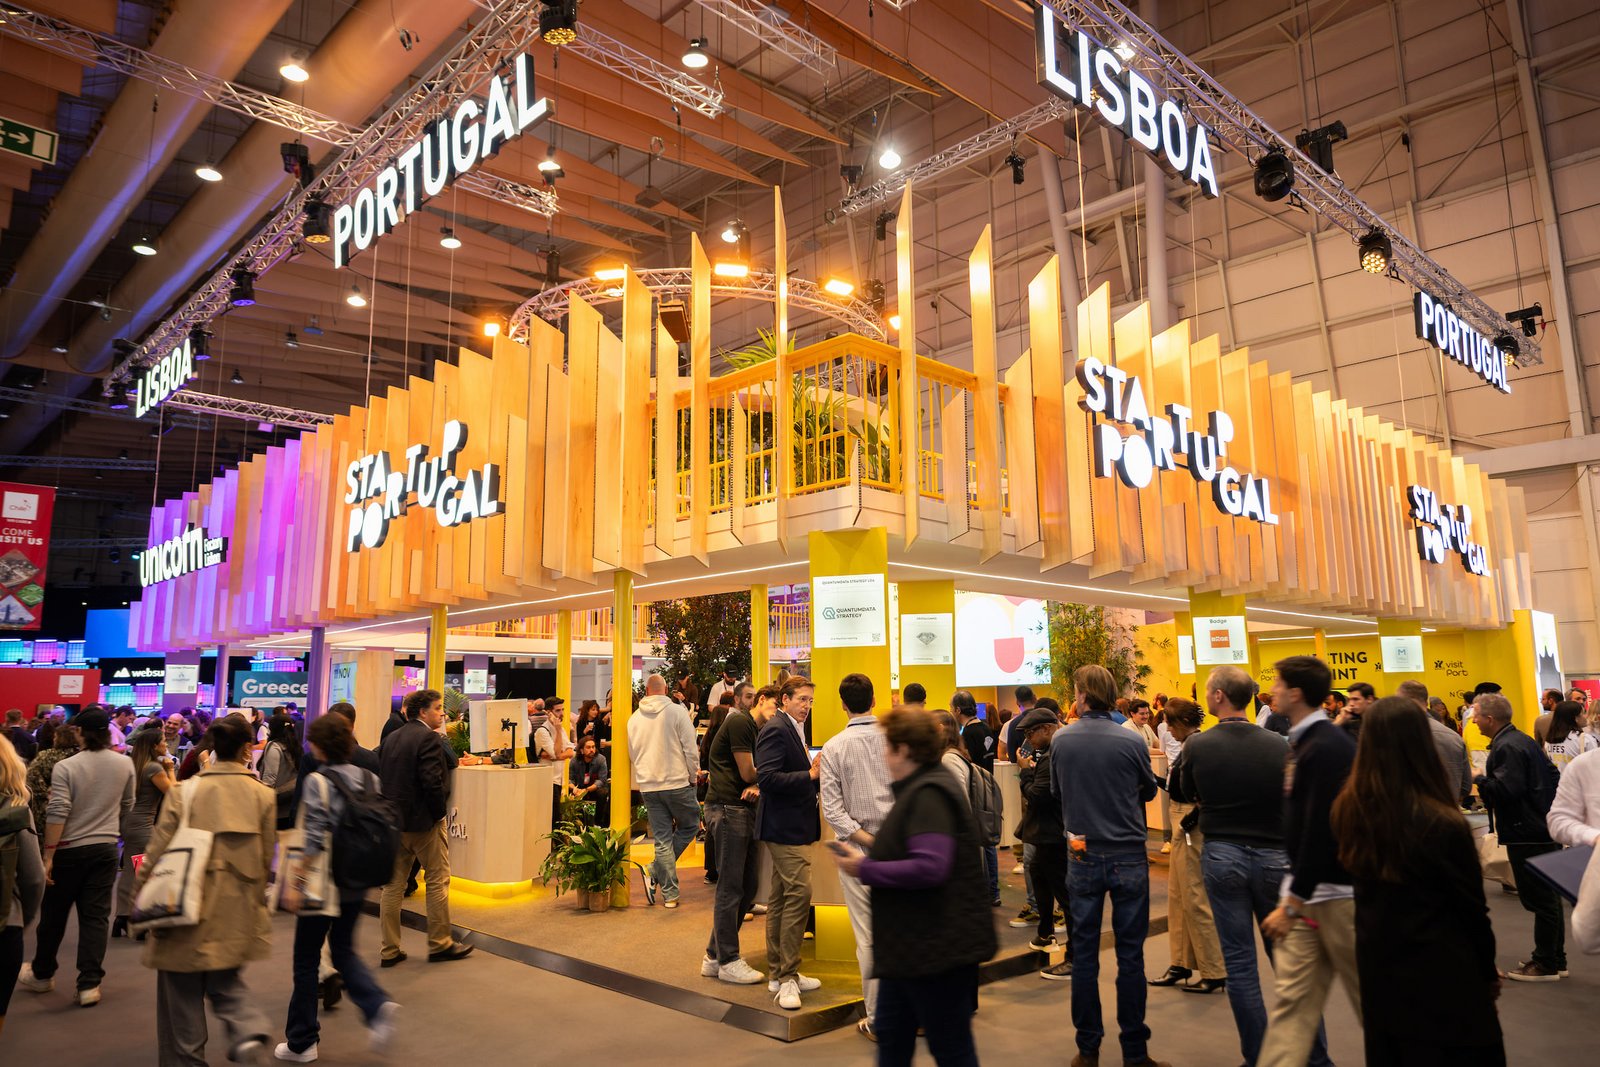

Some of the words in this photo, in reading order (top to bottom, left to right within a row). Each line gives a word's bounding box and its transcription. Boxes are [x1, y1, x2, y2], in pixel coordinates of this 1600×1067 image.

[1042, 4, 1219, 198] LISBOA
[334, 52, 549, 270] PORTUGAL
[136, 338, 192, 418] LISBOA
[1420, 291, 1512, 394] PORTUGAL
[0, 535, 25, 544] ISIT
[27, 537, 44, 545] US
[2, 527, 34, 537] COME
[242, 679, 309, 695] Greece
